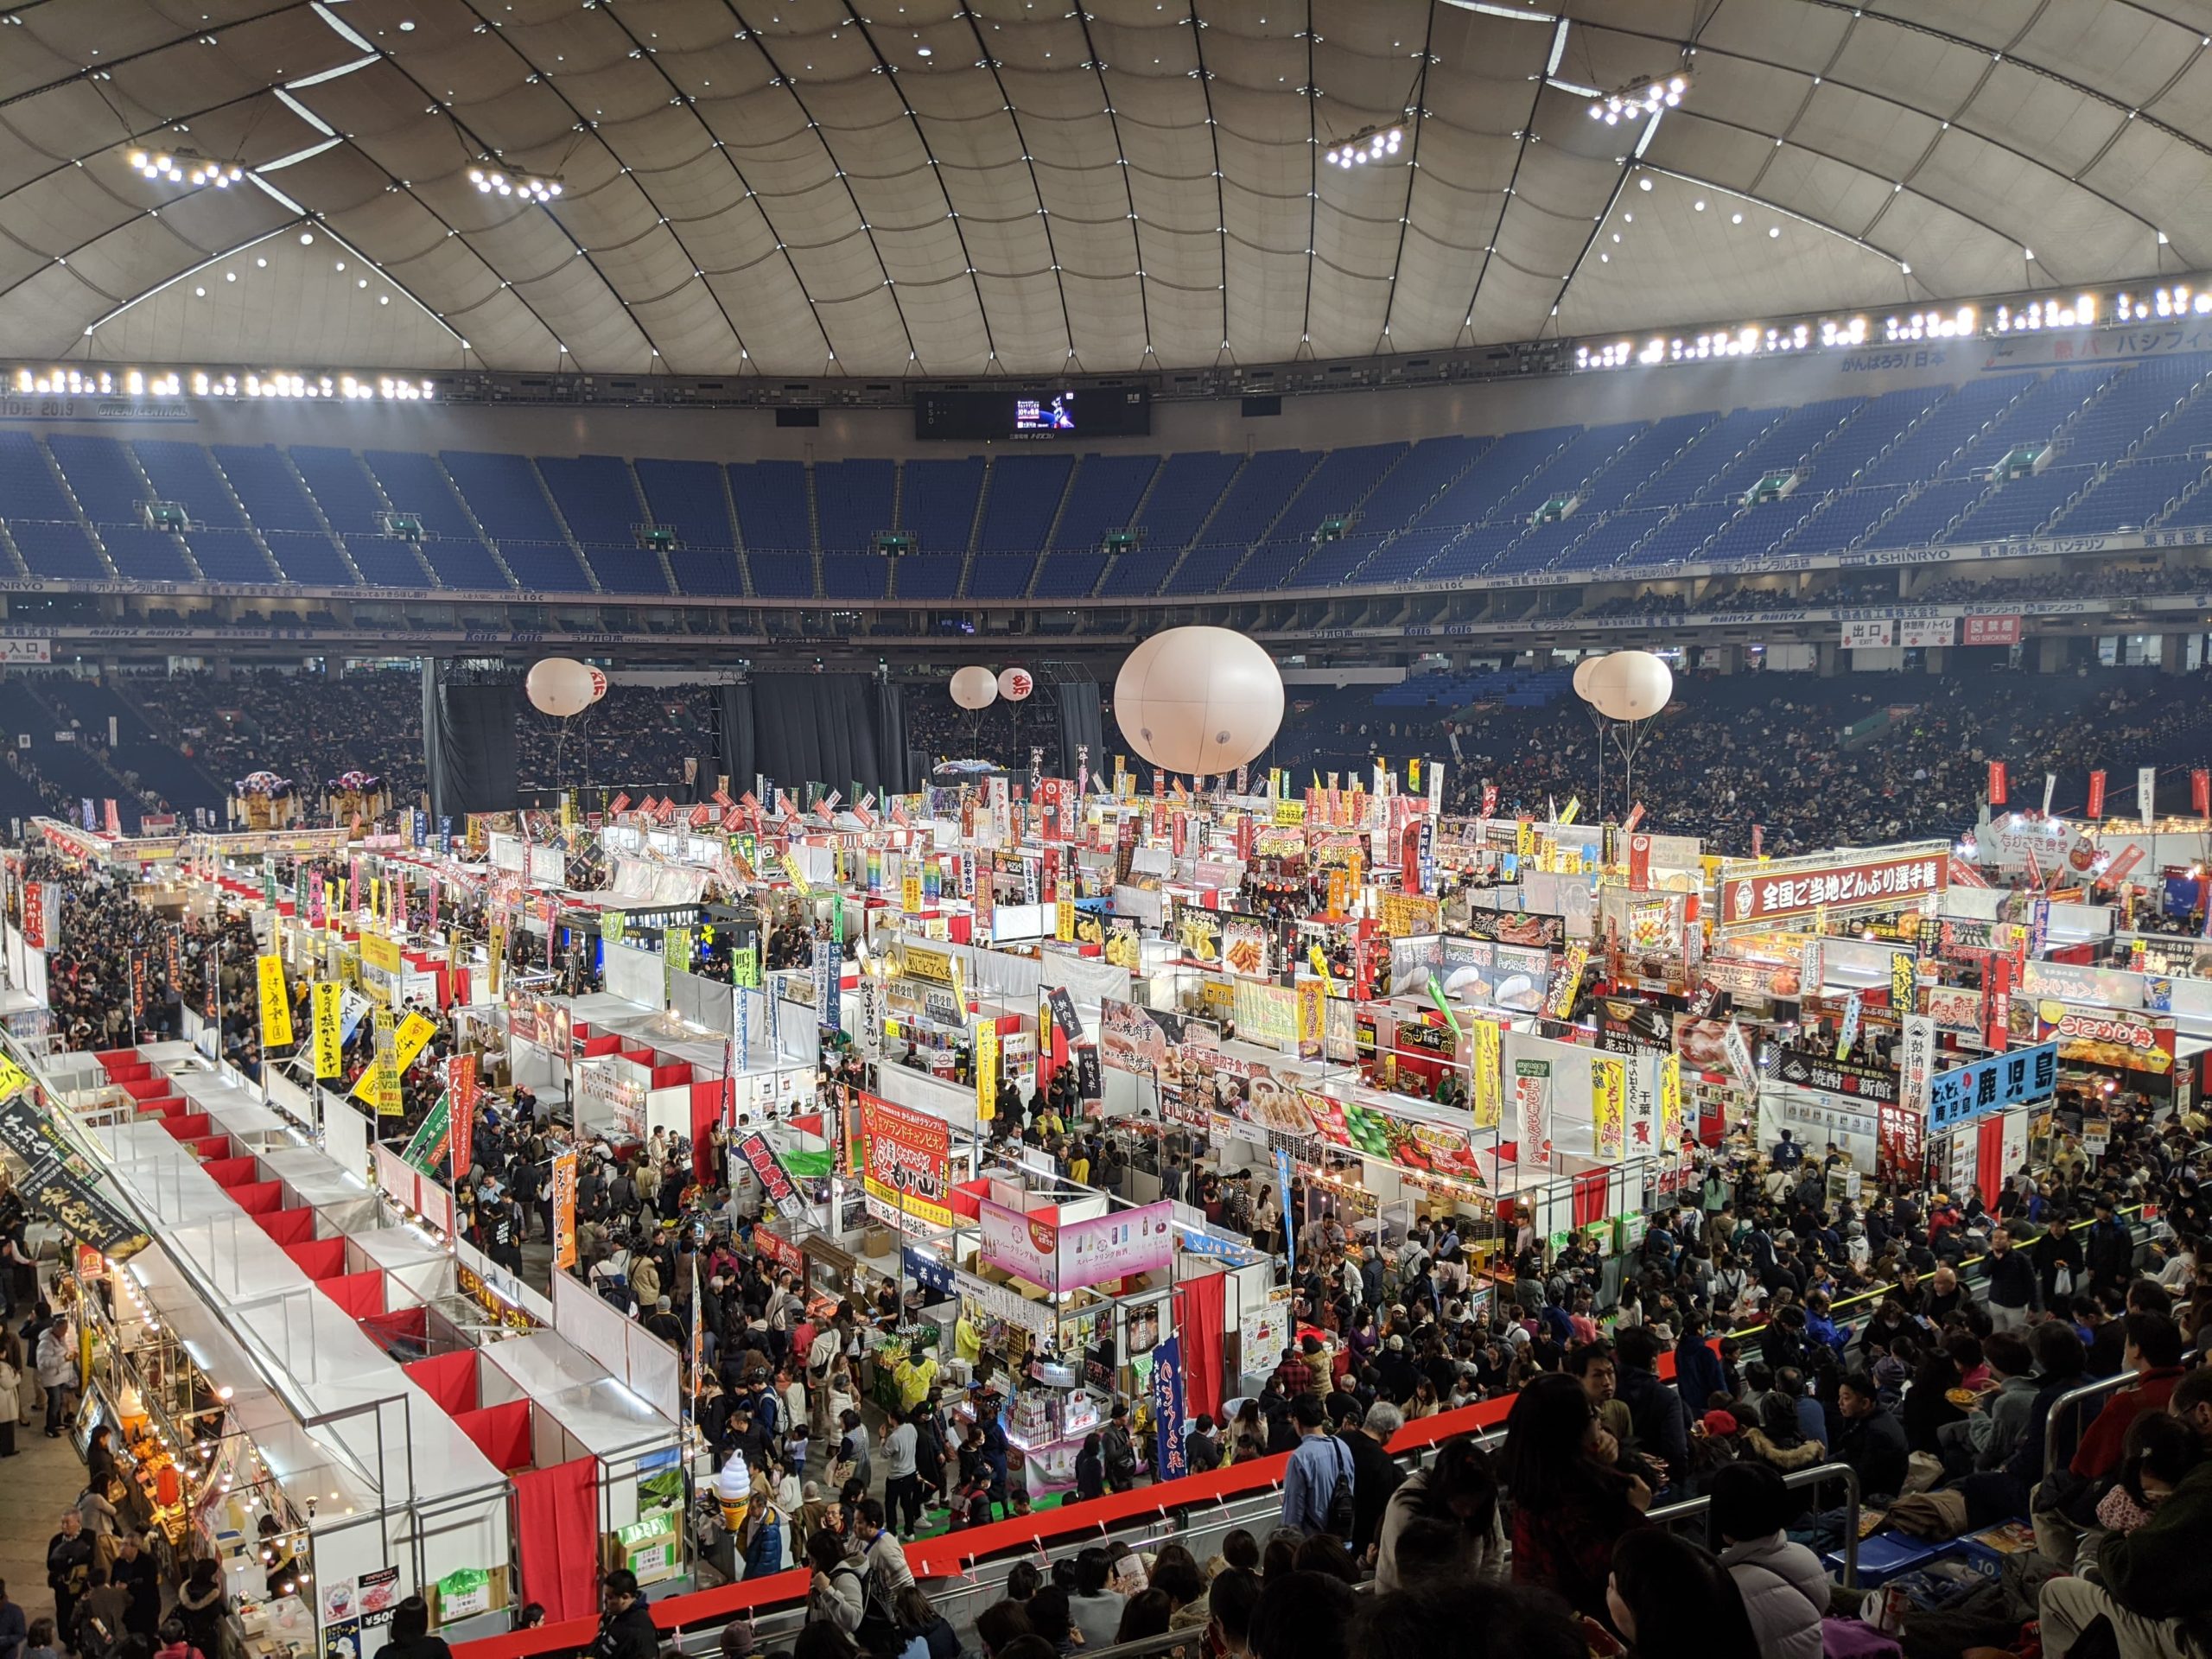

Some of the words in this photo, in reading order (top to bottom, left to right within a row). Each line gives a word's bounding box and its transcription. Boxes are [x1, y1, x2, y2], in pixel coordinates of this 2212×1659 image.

[41, 402, 74, 416] 2019
[2052, 538, 2105, 553] バンテリン
[1880, 550, 1950, 564] SHINRYO
[1853, 624, 1882, 638] 出口
[9, 642, 39, 654] 入口
[823, 835, 878, 850] 石川県
[1259, 837, 1295, 855] 米沢牛
[1999, 832, 2069, 855] たかさき食堂
[1763, 861, 1938, 912] 全国ご当地どんぶり選手権
[1122, 1021, 1153, 1042] 焼肉重
[2058, 1015, 2155, 1049] うにめし丼
[321, 1014, 336, 1073] 塩からあげ
[1122, 1051, 1154, 1073] すき焼重
[1810, 1067, 1892, 1100] 焼酎維新館
[1975, 1050, 2054, 1108] 鹿児島
[1160, 1096, 1196, 1122] 貴闘力
[1935, 1095, 1971, 1123] 鹿児島
